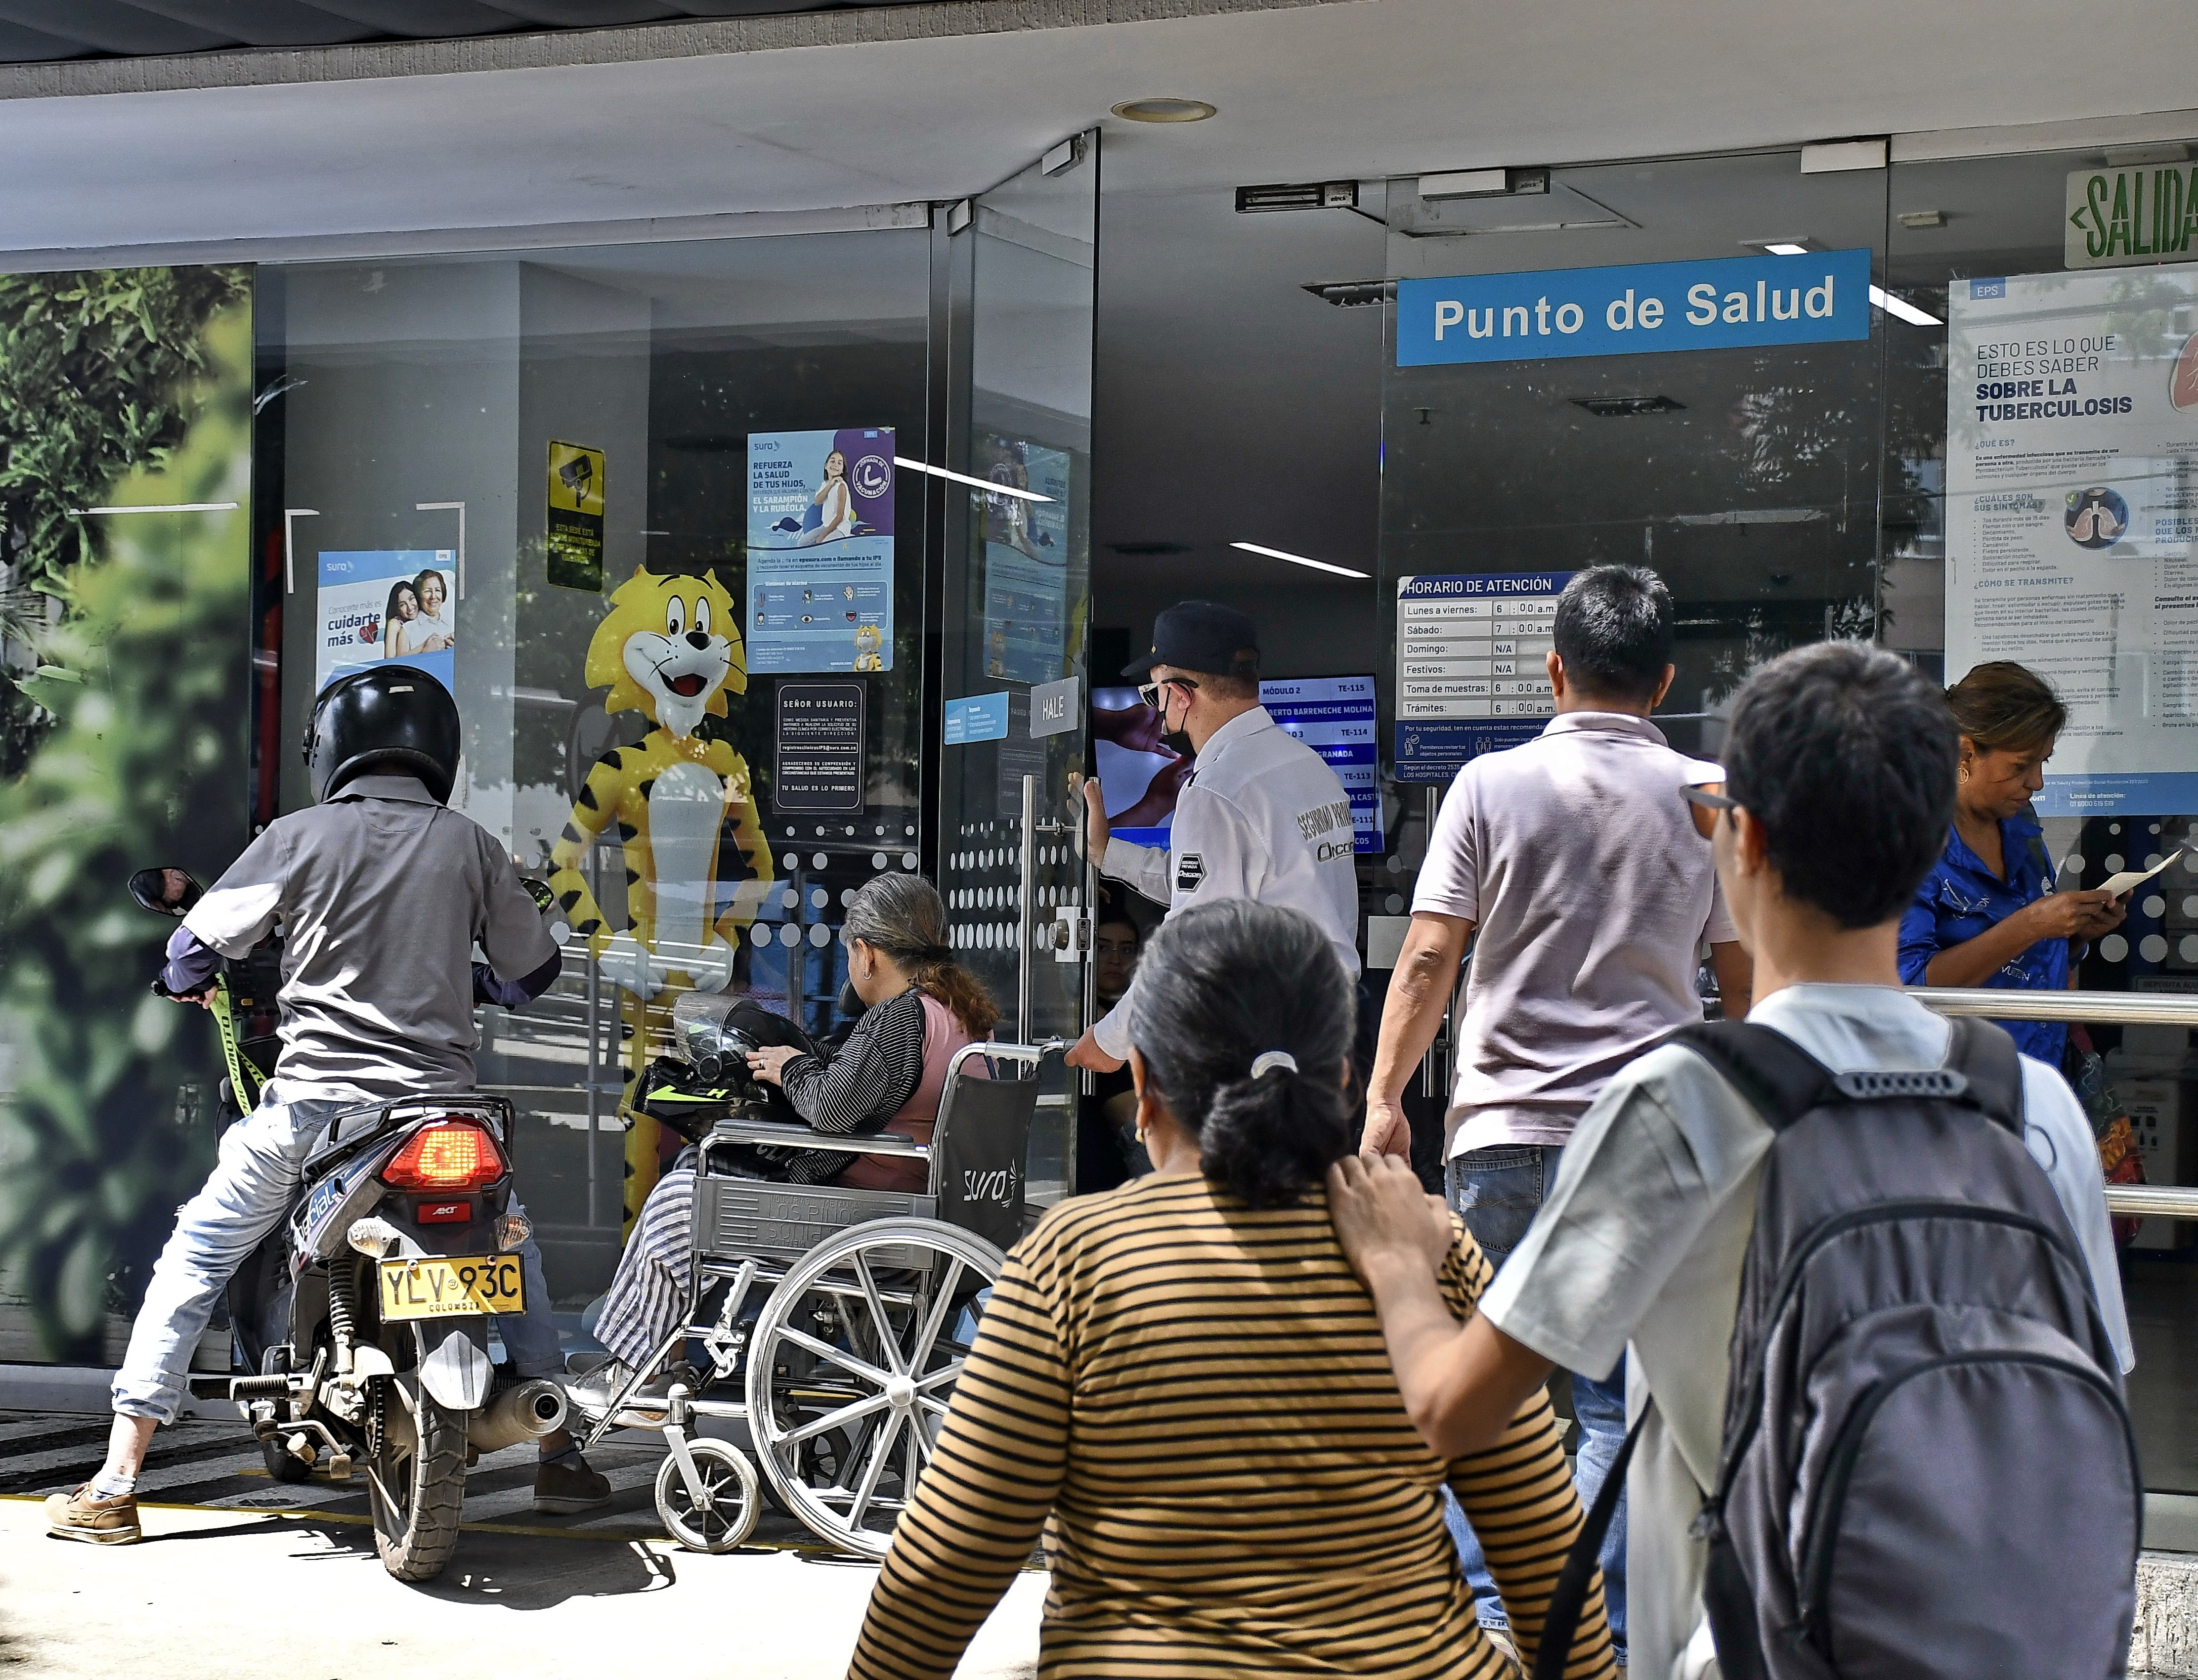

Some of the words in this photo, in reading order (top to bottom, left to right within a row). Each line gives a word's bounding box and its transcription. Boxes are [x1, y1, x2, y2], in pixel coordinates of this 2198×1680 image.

[2087, 167, 2198, 257] SALIDA
[1978, 286, 1998, 297] EPS
[1435, 295, 1584, 341] Punto
[1606, 289, 1664, 330] de
[1686, 275, 1834, 325] Salud
[1978, 343, 2021, 359] ESTO
[2026, 341, 2047, 356] ES
[2053, 339, 2075, 354] LO
[2080, 336, 2115, 354] QUE
[1978, 360, 2034, 378] DEBES
[2039, 357, 2099, 374] SABER
[1976, 380, 2043, 400] SOBRE
[2048, 378, 2077, 395] LA
[1976, 396, 2132, 422] TUBERCULOSIS
[753, 461, 792, 470] REFUERZA
[859, 458, 878, 468] JORNADA
[765, 470, 789, 478] SALUD
[781, 479, 806, 489] HIJOS,
[856, 479, 887, 495] VACUNACIÓN
[763, 494, 808, 503] SARAMPIÓN
[770, 502, 806, 512] RUBÉOLA.
[1407, 581, 1464, 594] HORARIO
[1466, 580, 1483, 592] DE
[1486, 576, 1552, 592] ATENCIÓN
[2019, 577, 2073, 586] TRANSMITE?
[329, 604, 359, 614] Conocerte
[360, 600, 373, 610] más
[1407, 605, 1434, 615] Lunes
[1443, 604, 1478, 614] viernes:
[1496, 605, 1502, 613] 6
[1537, 605, 1556, 613] a.m.
[328, 612, 381, 630] cuidarte
[1407, 625, 1443, 635] Sábado:
[328, 633, 353, 647] más
[1407, 645, 1448, 656] Domingo:
[1496, 644, 1511, 654] N/A
[1407, 665, 1446, 674] Festivos:
[1495, 665, 1511, 673] N/A
[1263, 686, 1294, 695] MÓDULO
[1406, 685, 1430, 694] Toma
[1432, 684, 1442, 693] de
[1445, 684, 1488, 692] muestras:
[783, 699, 811, 708] SEÑOR
[1042, 695, 1064, 721] HALE
[1406, 704, 1447, 713] Trámites:
[1294, 707, 1341, 715] BARRENECHE
[1343, 705, 1373, 714] MOLINA
[1297, 806, 1333, 841] SEGURIDAD
[963, 1169, 1007, 1201] sura
[431, 1206, 458, 1216] AKT
[769, 1203, 801, 1221] LOS
[808, 1206, 861, 1224] PINOS
[386, 1268, 445, 1305] YLV
[459, 1264, 518, 1303] 93C
